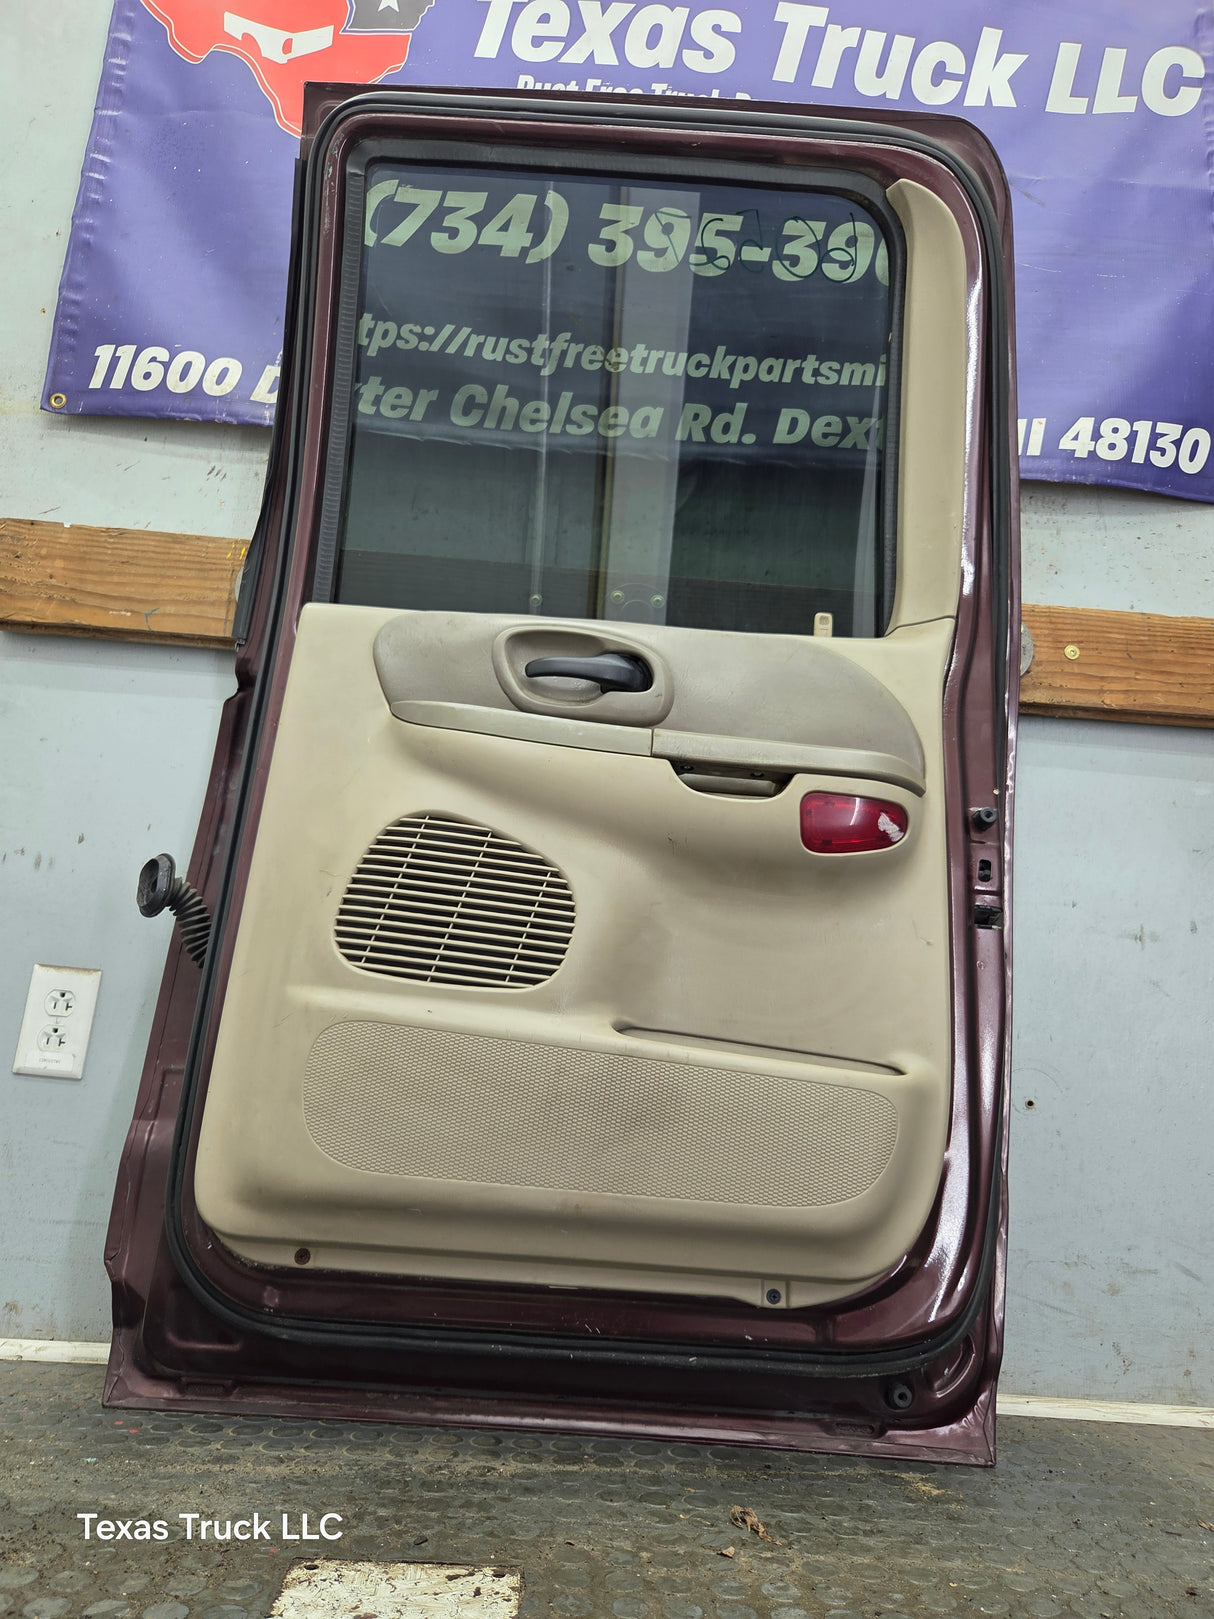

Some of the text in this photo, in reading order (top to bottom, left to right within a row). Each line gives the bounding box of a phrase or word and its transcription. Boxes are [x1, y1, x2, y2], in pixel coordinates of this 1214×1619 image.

[473, 0, 1206, 117] Texas Truck LLC
[364, 179, 570, 264] (734)
[88, 344, 243, 397] 11600
[450, 383, 665, 439] Chelsea
[675, 402, 757, 444] Rd.
[1058, 417, 1212, 475] 48130
